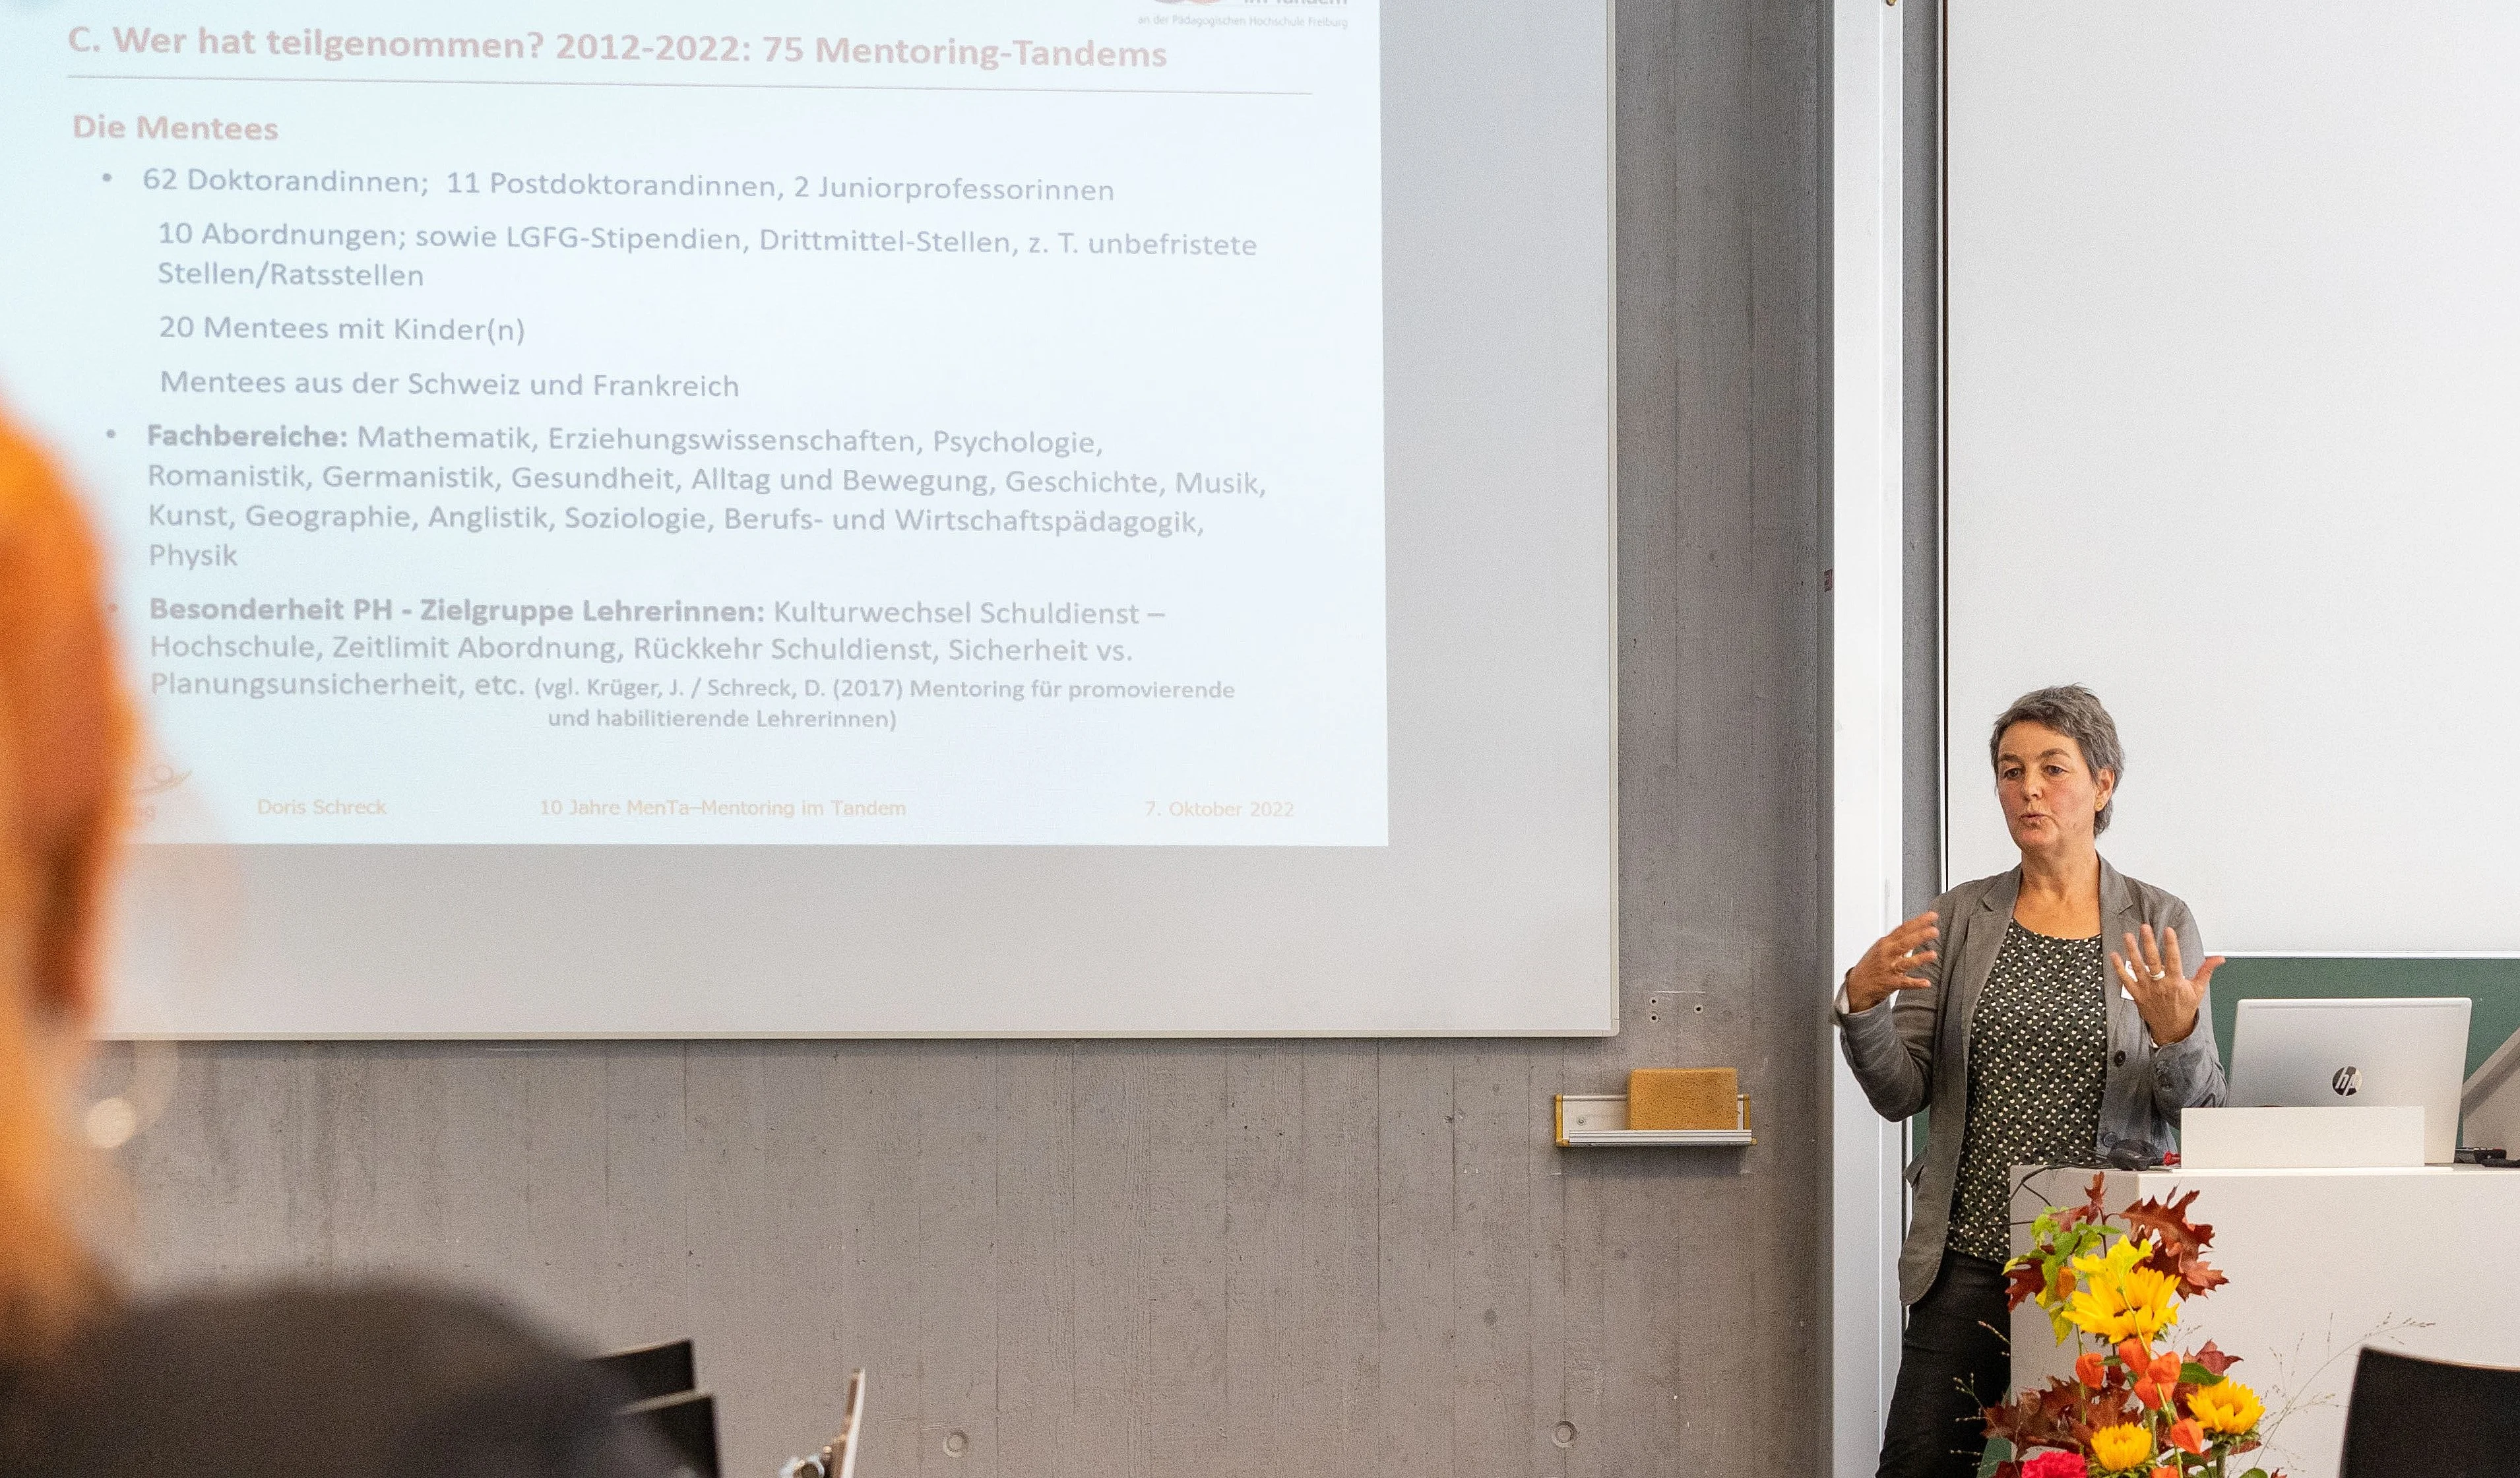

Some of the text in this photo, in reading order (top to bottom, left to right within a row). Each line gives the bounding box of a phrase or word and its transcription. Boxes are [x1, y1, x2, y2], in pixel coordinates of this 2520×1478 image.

[1138, 15, 1348, 30] an der Pädagogischen Hochschule Freiburg
[69, 26, 1166, 71] C. Wer hat teilgenommen? 2012-2022: 75 Mentoring-Tandems
[74, 113, 278, 141] Die Mentees
[143, 168, 1114, 204] 62 Doktorandinnen; 11 Postdoktorandinnen, 2 Juniorprofessorinnen
[160, 222, 1257, 257] 10 Abordnungen; sowie LGFG-Stipendien, Drittmittel-Stellen, z. T. unbefristete
[159, 261, 424, 289] Stellen/Ratsstellen
[160, 315, 524, 346] 20 Mentees mit Kinder(n)
[162, 370, 739, 397] Mentees aus der Schweiz und Frankreich
[148, 424, 1102, 458] Fachbereiche: Mathematik, Erziehungswissenschaften, Psychologie,
[149, 464, 1265, 498] Romanistik, Germanistik, Gesundheit, Alltag und Bewegung, Geschichte, Musik,
[150, 504, 1203, 538] Kunst, Geographie, Anglistik, Soziologie, Berufs- und Wirtschaftspädagogik,
[150, 543, 237, 571] Physik
[150, 597, 344, 620] Besonderheit
[354, 598, 392, 620] PH
[420, 598, 573, 626] Zielgruppe
[583, 599, 764, 622] Lehrerinnen:
[775, 600, 970, 623] Kulturwechsel
[981, 602, 1139, 624] Schuldienst
[152, 635, 1132, 664] Hochschule, Zeitlimit Abordnung, Rückkehr Schuldienst, Sicherheit vs.
[152, 672, 1235, 702] Planungsunsicherheit, etc. (vgl. Krüger, J. / Schreck, D. (2017) Mentoring für promovierende
[548, 709, 897, 732] und habilitierende Lehrerinnen)
[257, 798, 387, 815] Doris Schreck
[542, 799, 563, 816] 10
[569, 799, 621, 816] Jahre
[802, 800, 824, 816] im
[831, 800, 906, 816] Tandem
[1146, 800, 1294, 818] 7. Oktober 2022
[2333, 1066, 2358, 1096] hp
